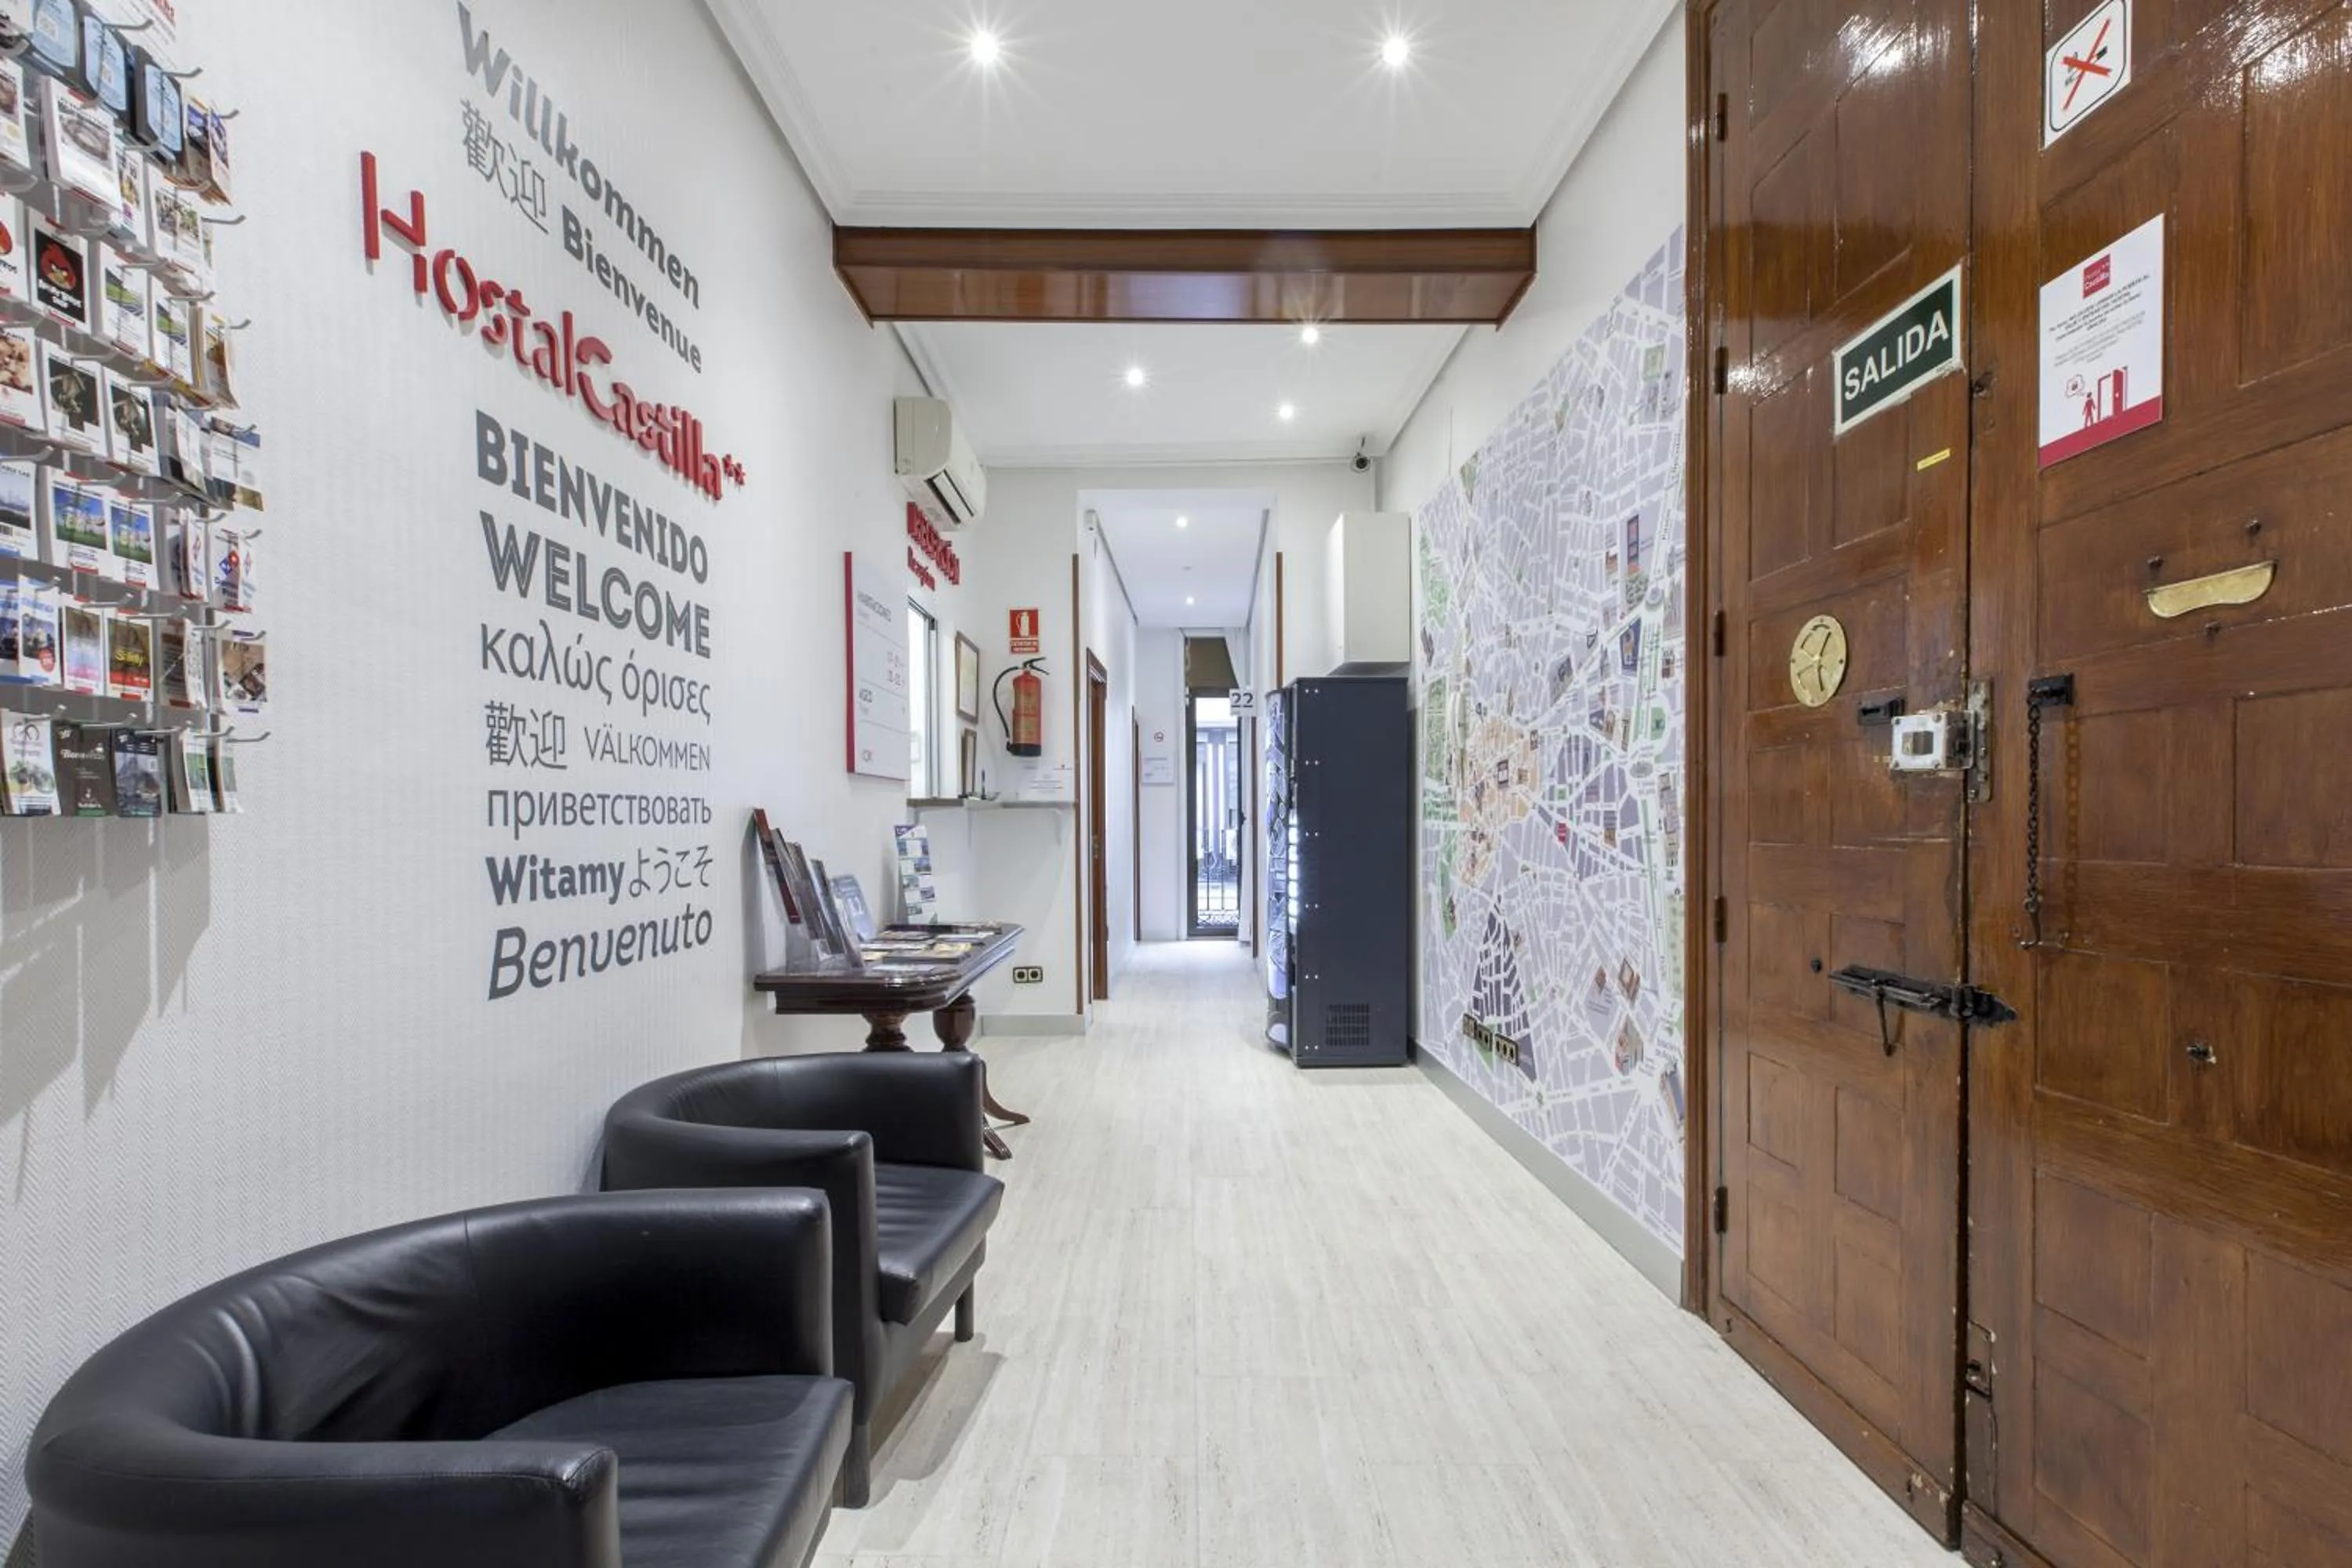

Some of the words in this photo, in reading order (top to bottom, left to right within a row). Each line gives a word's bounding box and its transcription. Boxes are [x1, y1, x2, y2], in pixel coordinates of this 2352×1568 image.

[457, 0, 700, 309] Willkommen
[459, 99, 550, 234] 歡迎
[561, 204, 702, 373] Bienvenue
[1845, 310, 1949, 401] SALIDA
[476, 409, 708, 584] BIENVENIDO
[479, 510, 711, 659] WELCOME
[481, 619, 612, 706] καλώς
[622, 648, 711, 725] όρισες
[1231, 692, 1253, 708] 22
[485, 700, 568, 770] 歡迎
[584, 722, 711, 771] VÄLKOMMEN
[488, 789, 712, 840] приветствовать
[485, 854, 626, 906] Witamy
[629, 844, 713, 898] ようこそ
[488, 902, 713, 1000] Benvenuto
